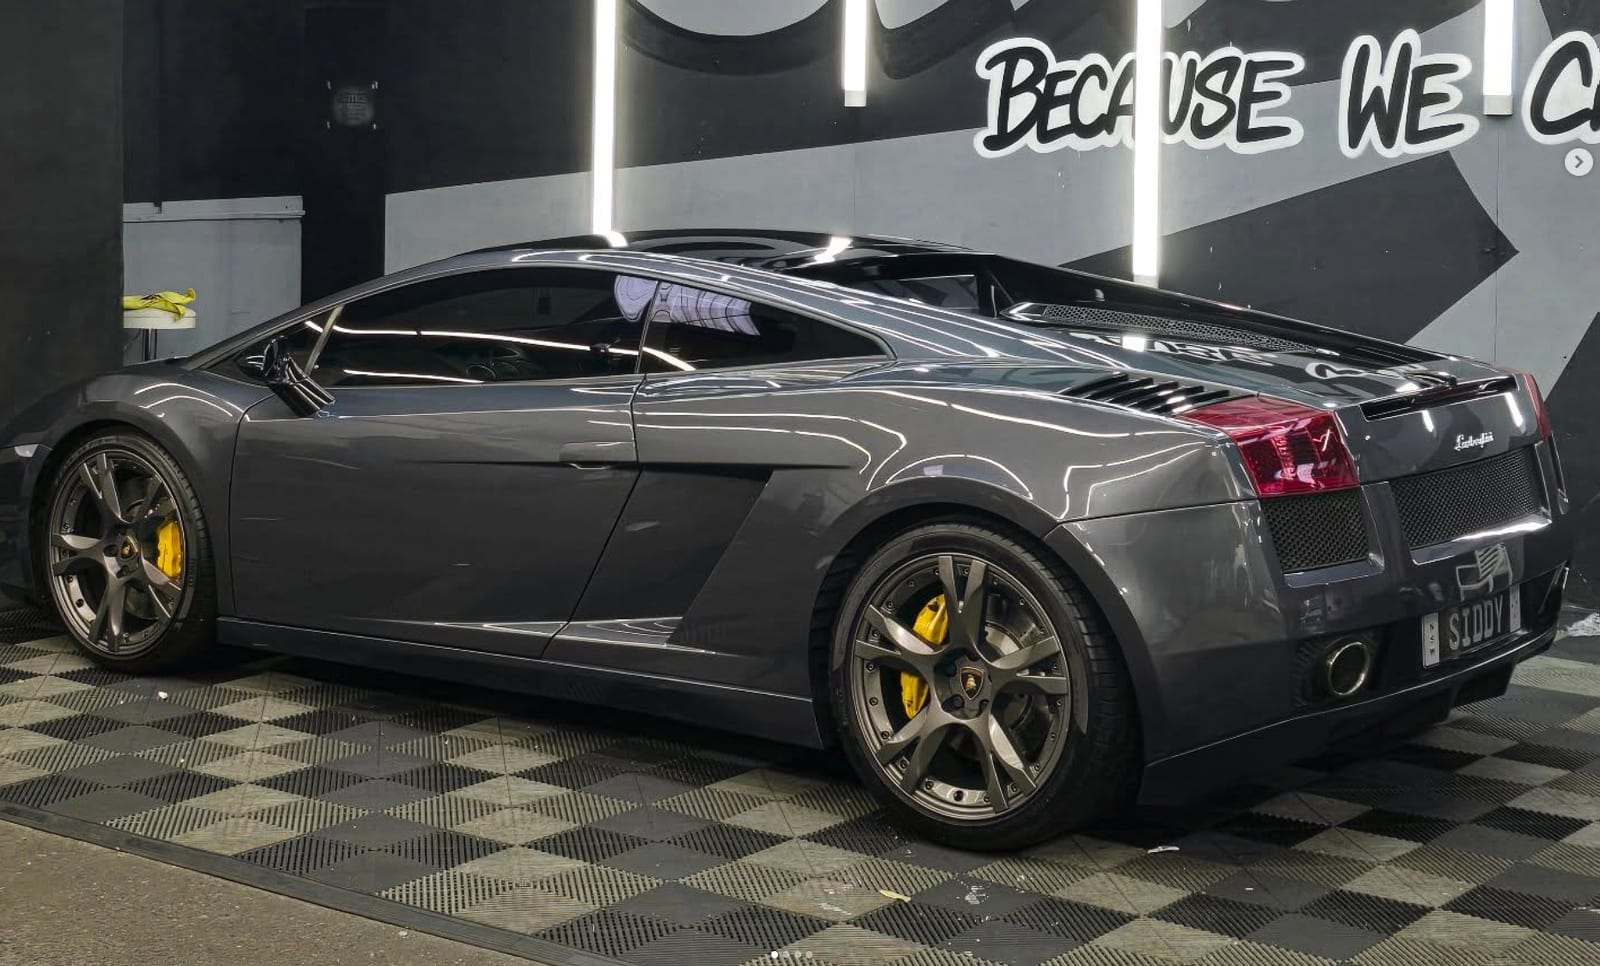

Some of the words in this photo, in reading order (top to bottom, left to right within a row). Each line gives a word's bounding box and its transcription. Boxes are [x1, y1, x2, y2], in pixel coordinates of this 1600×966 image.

[981, 44, 1296, 153] BECAUSE
[1346, 40, 1466, 151] WE
[1530, 39, 1600, 137] C
[1448, 594, 1504, 651] SIDDY
